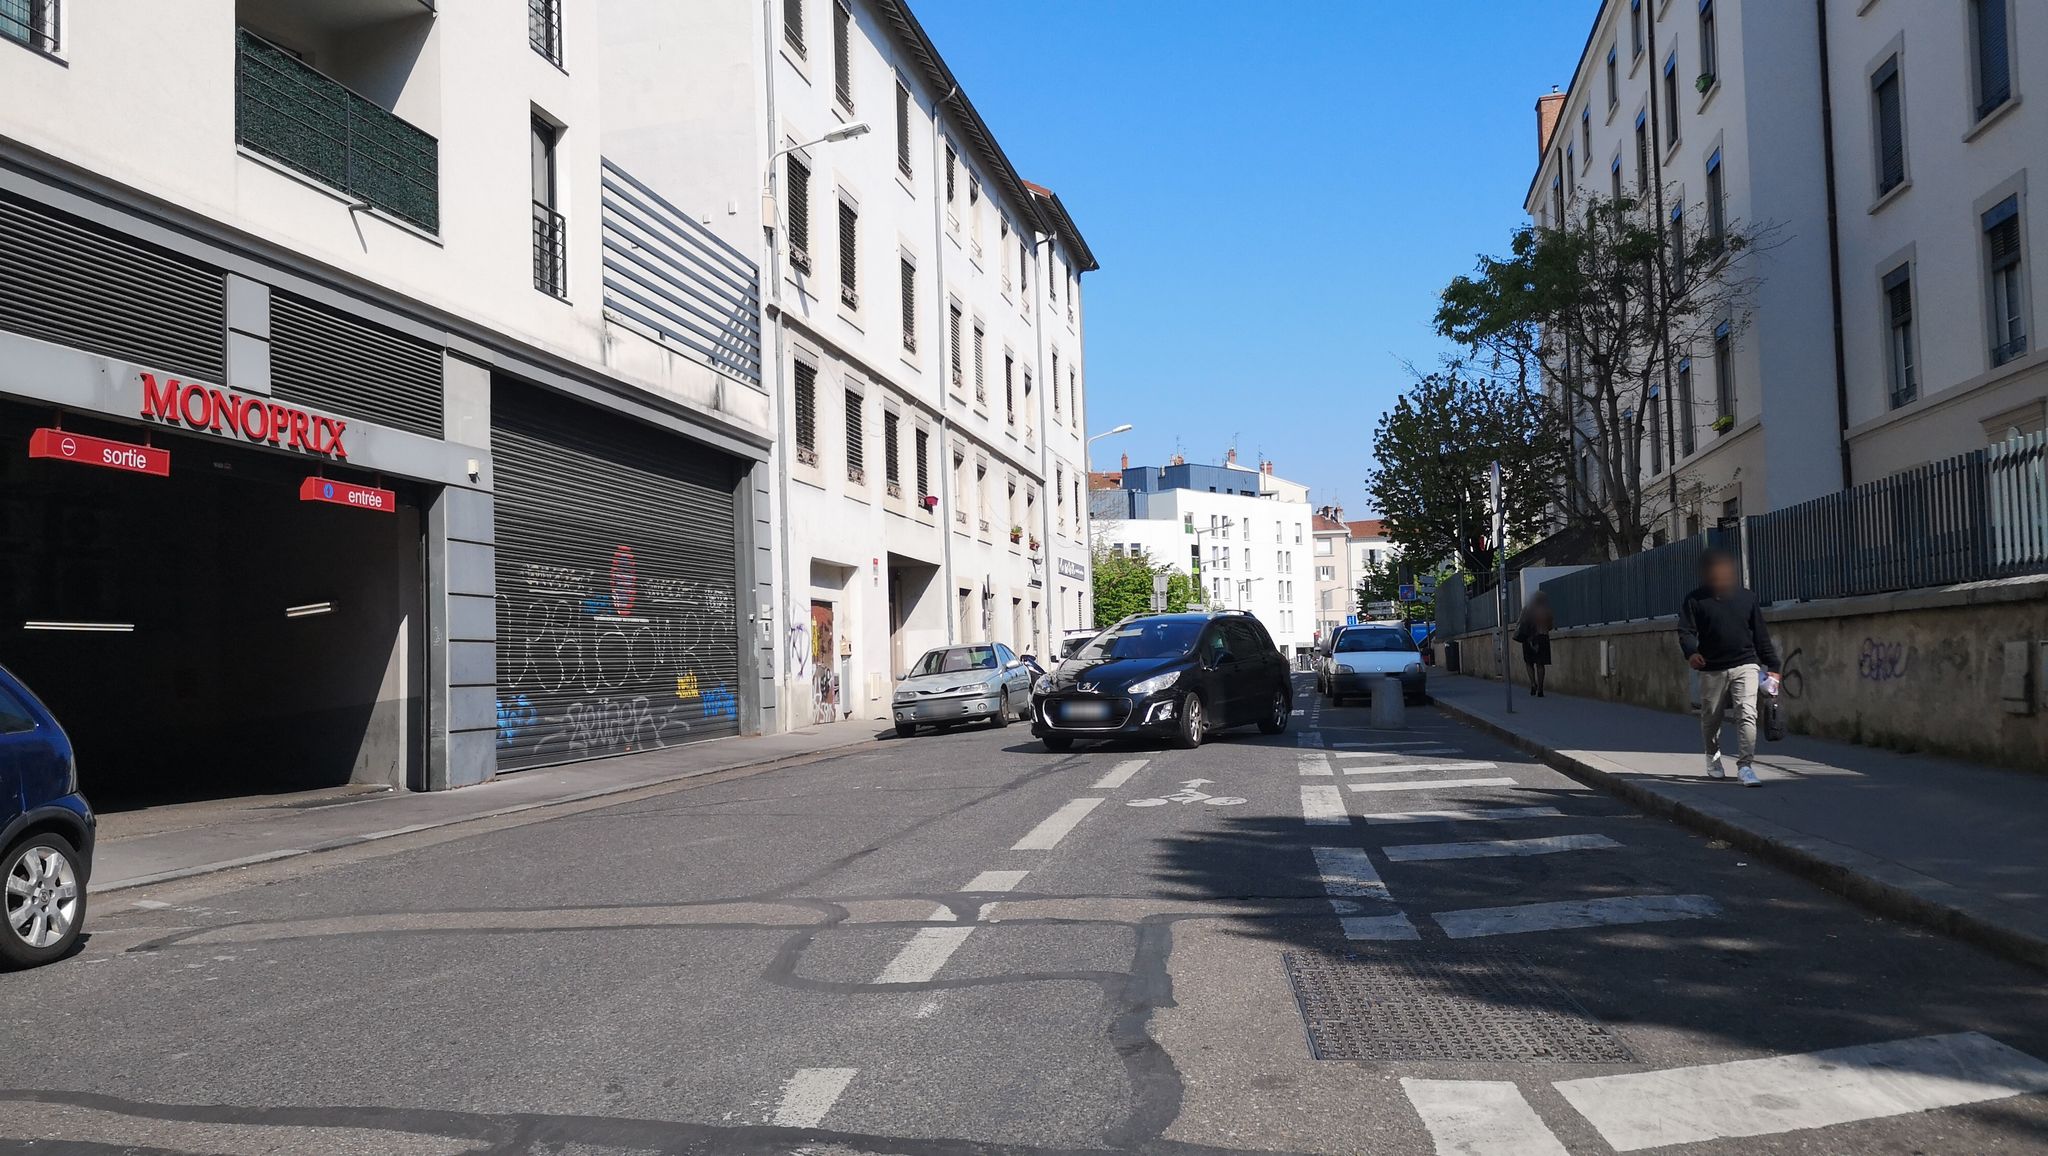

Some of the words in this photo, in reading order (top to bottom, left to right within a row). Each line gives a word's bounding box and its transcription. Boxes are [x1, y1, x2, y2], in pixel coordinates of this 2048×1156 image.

[140, 373, 348, 457] MONOPRIX
[103, 448, 147, 469] sortie
[348, 490, 382, 508] entrée
